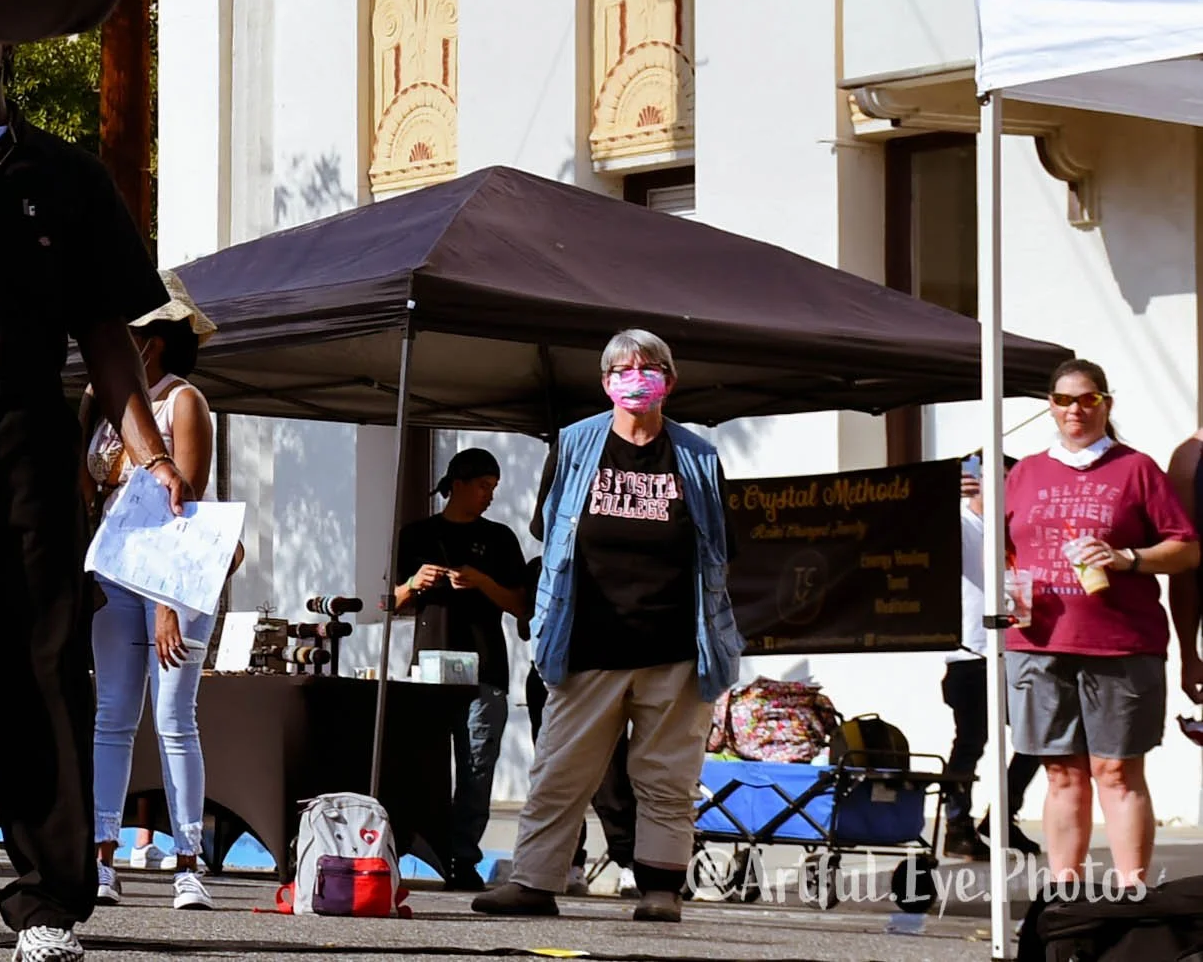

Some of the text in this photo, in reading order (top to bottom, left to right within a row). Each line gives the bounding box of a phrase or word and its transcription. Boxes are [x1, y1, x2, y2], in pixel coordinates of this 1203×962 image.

[743, 484, 817, 522] Crystal
[823, 474, 909, 510] Methods
[1037, 482, 1121, 500] BELIEVE
[589, 490, 670, 521] COLLEGE
[1027, 503, 1114, 526] FATHER
